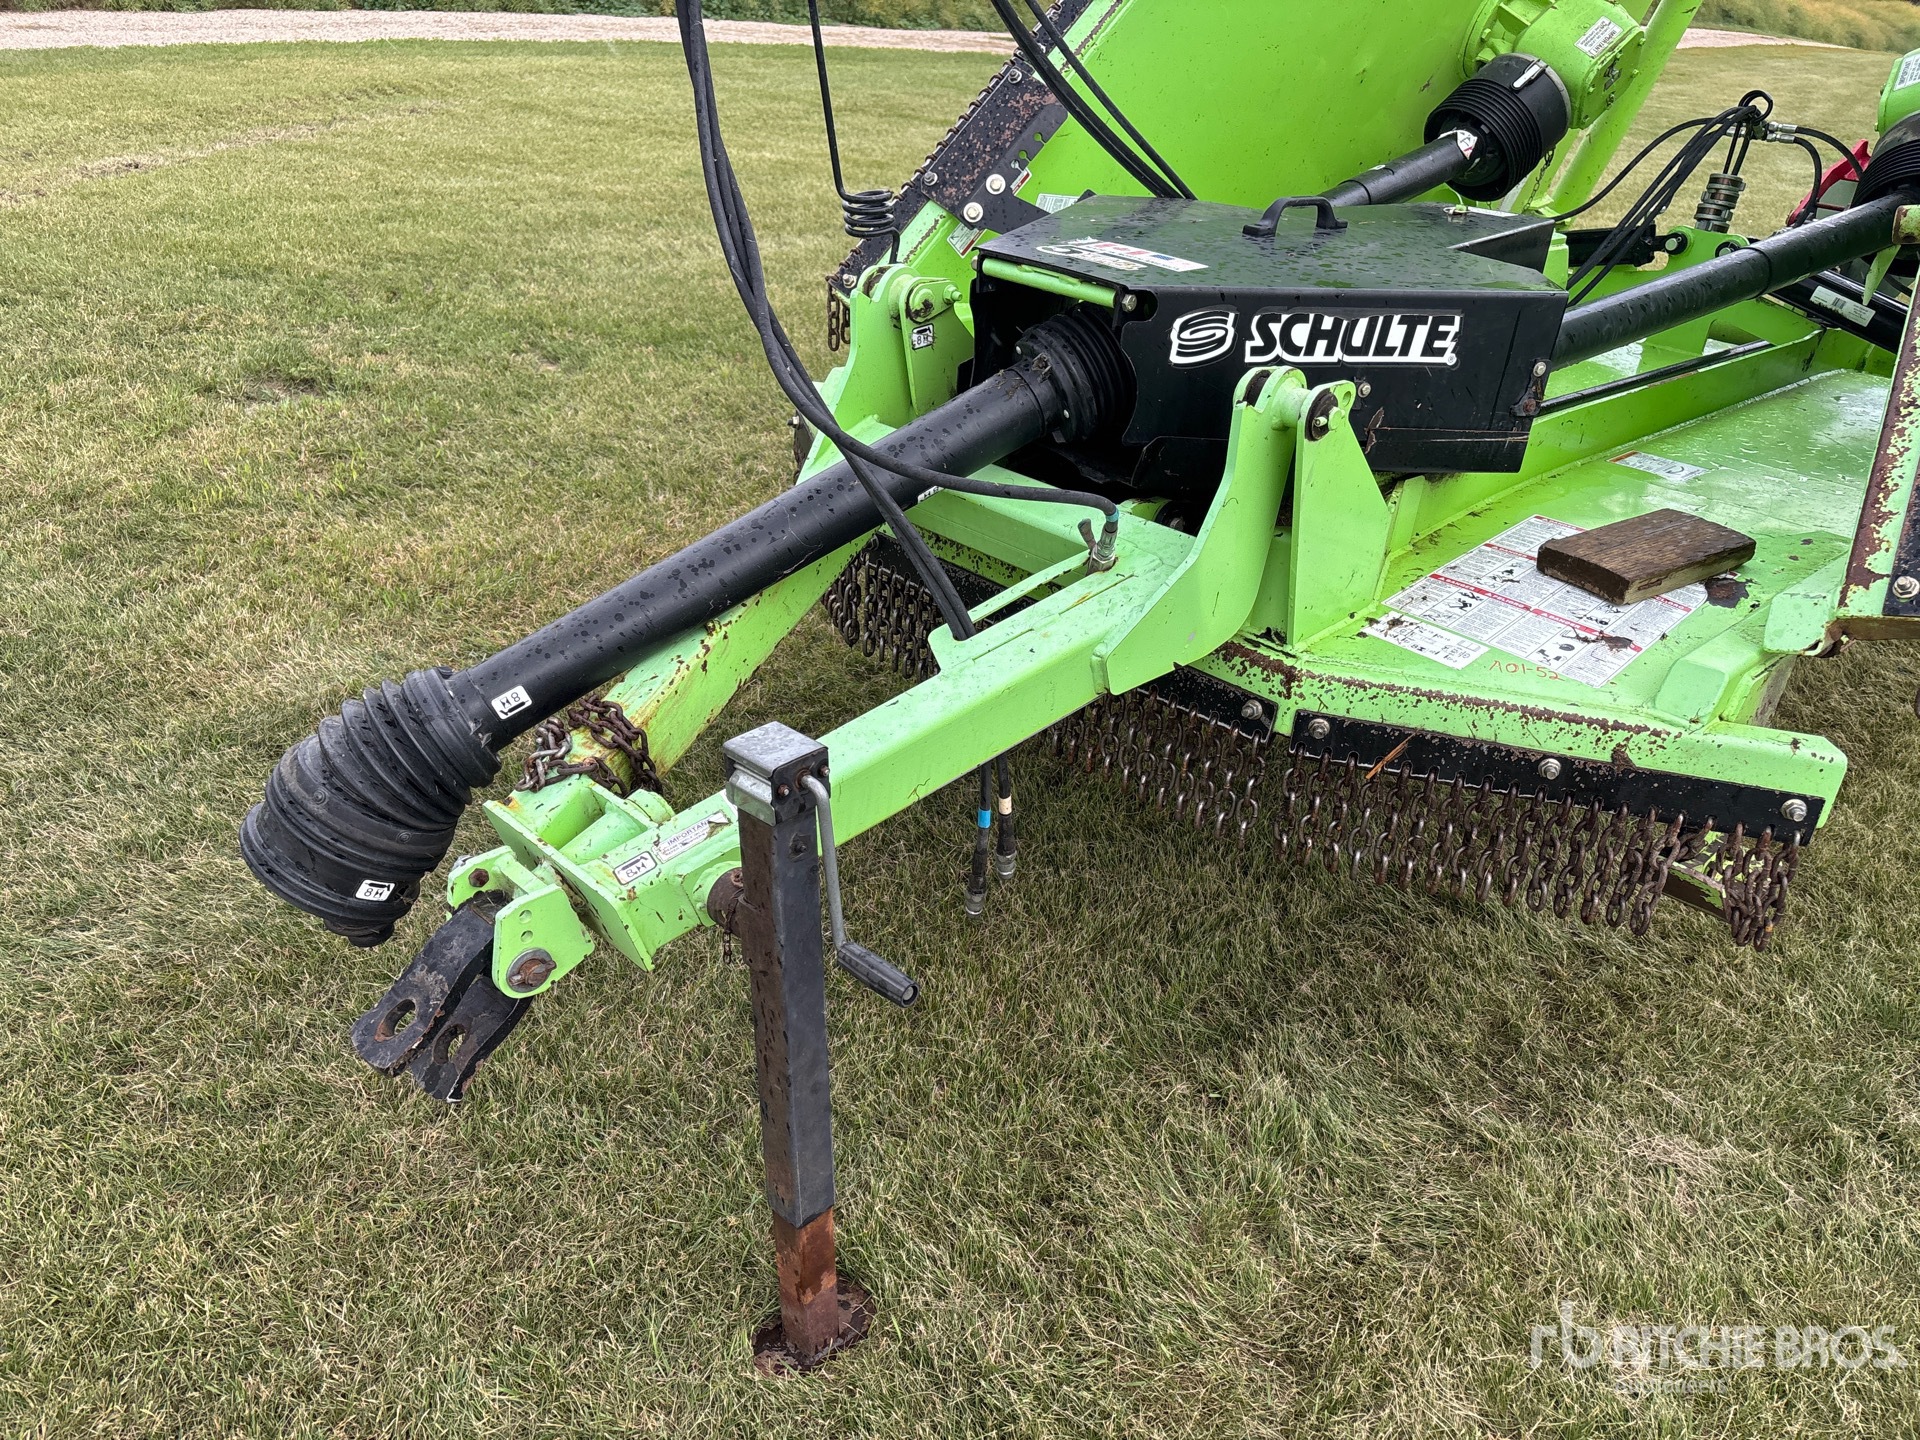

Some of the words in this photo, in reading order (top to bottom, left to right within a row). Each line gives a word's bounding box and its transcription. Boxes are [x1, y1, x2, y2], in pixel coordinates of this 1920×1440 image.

[1592, 29, 1617, 53] IMPORTANT
[1246, 312, 1458, 361] SCHULTE
[1445, 579, 1475, 591] DANGER
[1492, 595, 1525, 608] PELIGRO
[1548, 615, 1580, 629] DANGER
[667, 819, 710, 846] IMPORTAN
